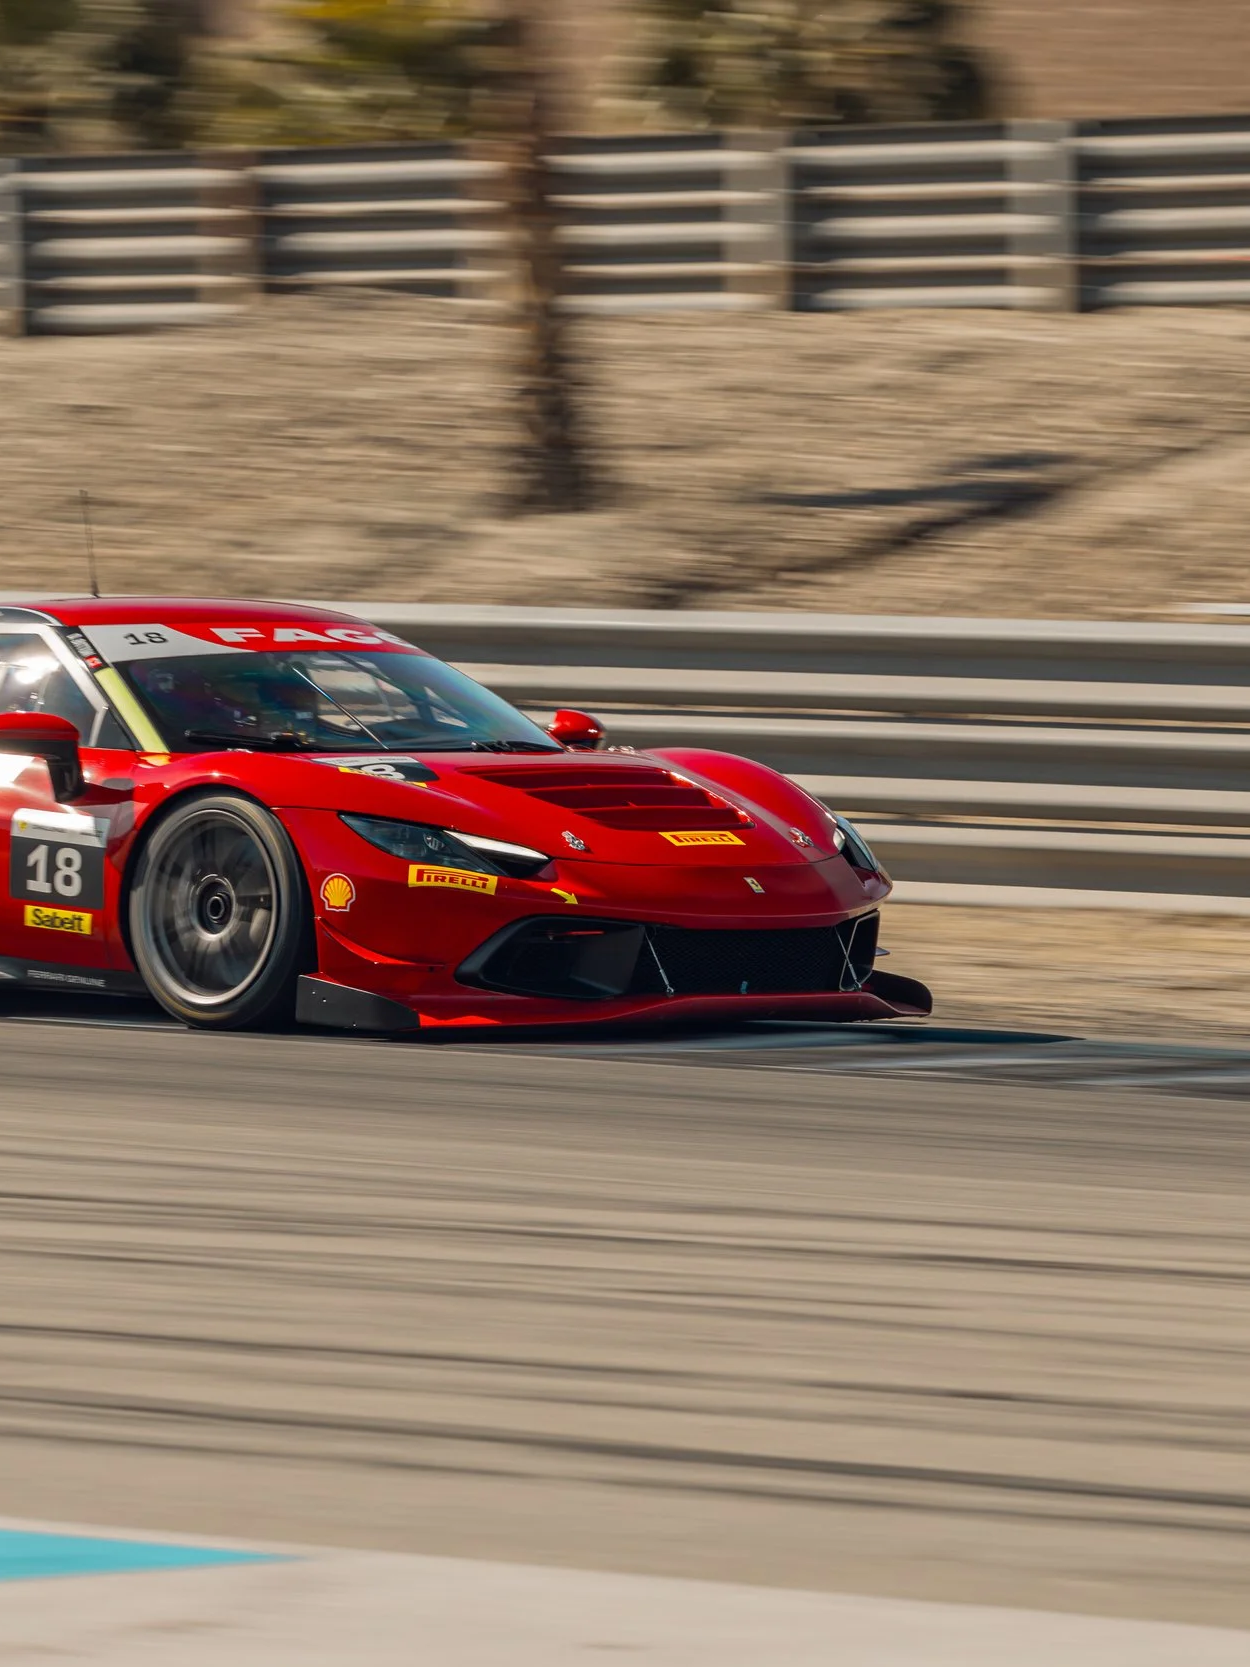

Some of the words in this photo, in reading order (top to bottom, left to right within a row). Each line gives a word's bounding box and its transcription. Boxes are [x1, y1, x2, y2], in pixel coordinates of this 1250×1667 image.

[123, 632, 169, 645] 18
[669, 833, 735, 843] PIRELLI
[26, 844, 82, 897] 18
[415, 868, 490, 889] PIRELLI
[31, 908, 84, 932] Sabelt
